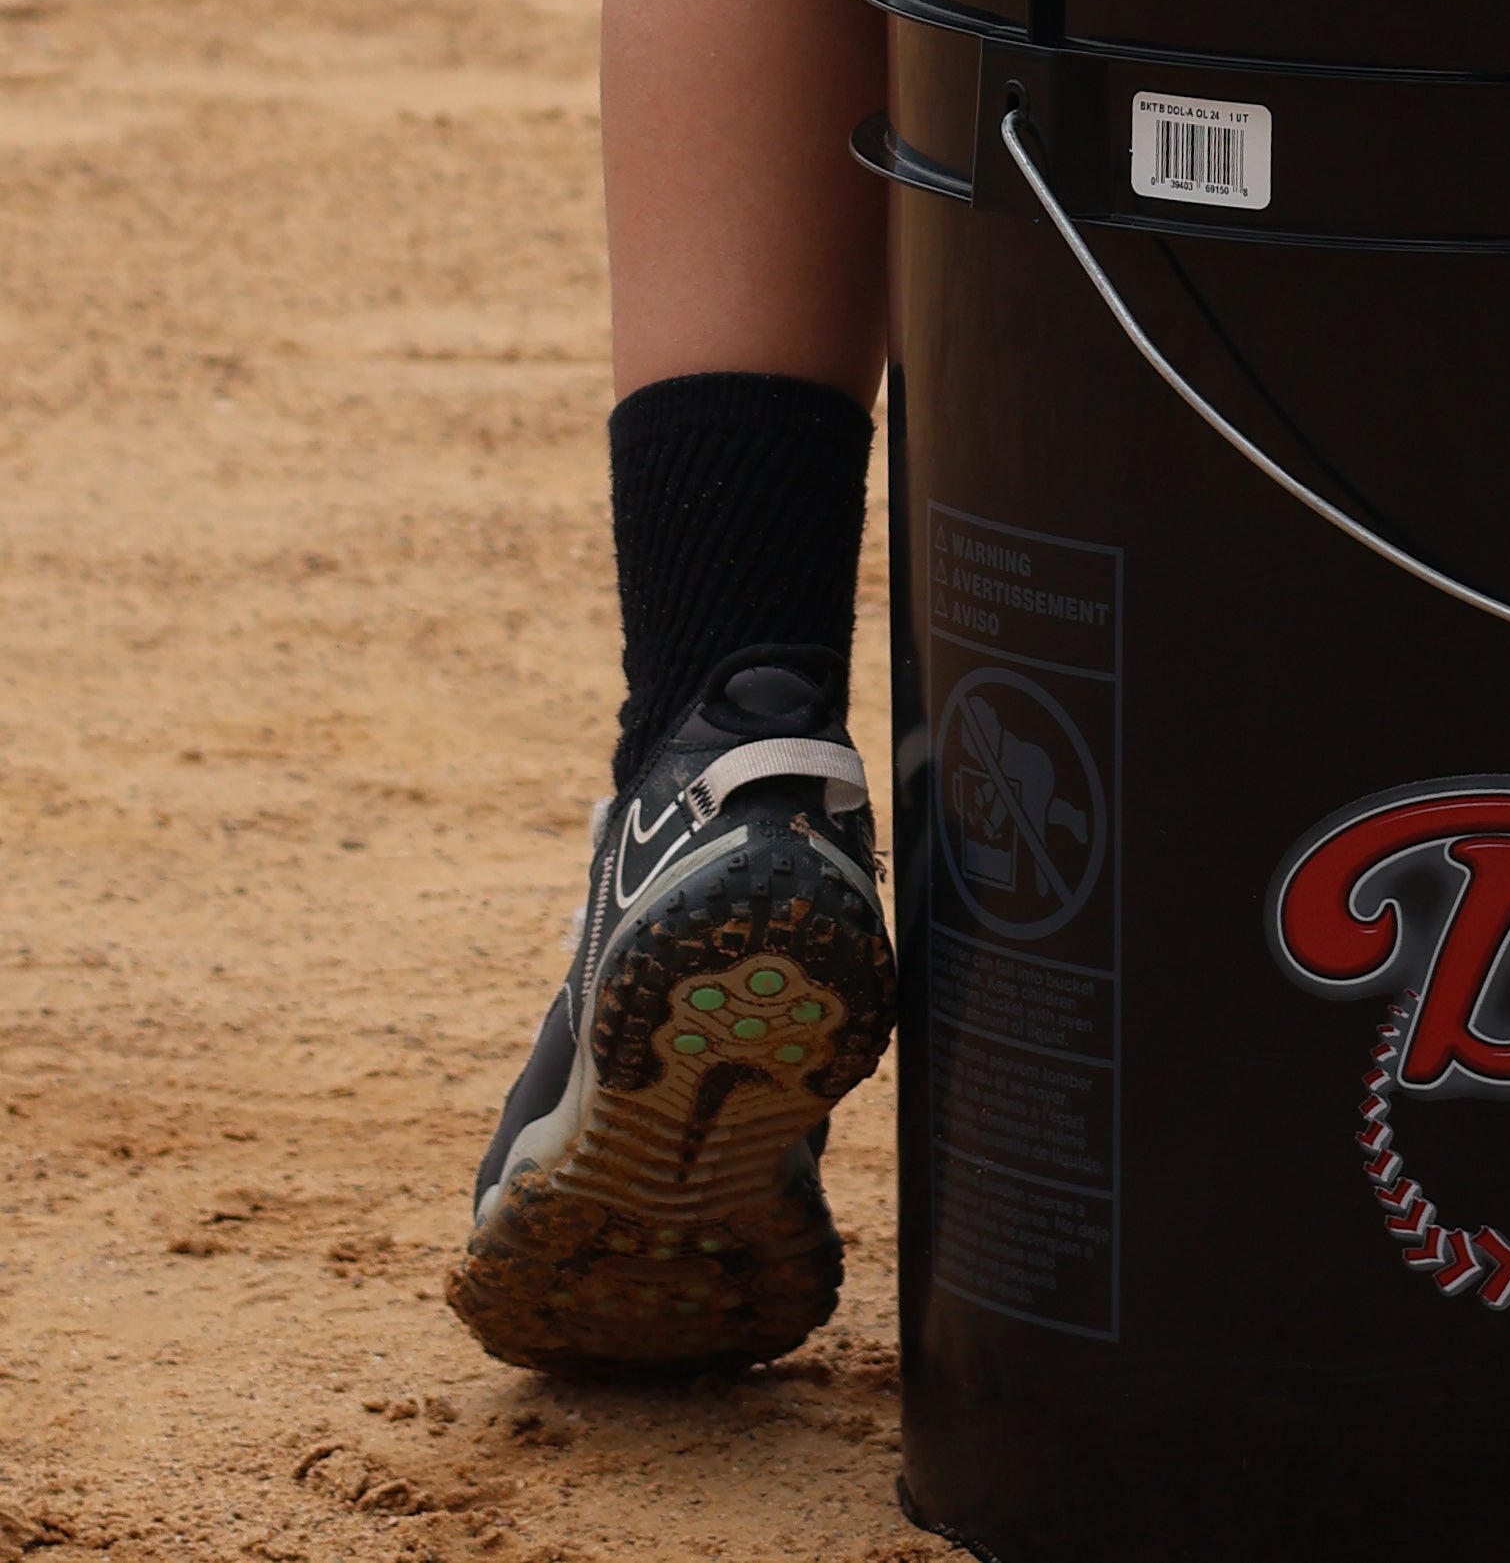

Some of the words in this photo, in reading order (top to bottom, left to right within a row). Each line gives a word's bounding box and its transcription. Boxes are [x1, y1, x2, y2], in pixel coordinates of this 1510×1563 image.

[952, 532, 1032, 578] WARNING
[952, 568, 1110, 626] AVERTISSEMENT
[952, 600, 1000, 636] AVISO
